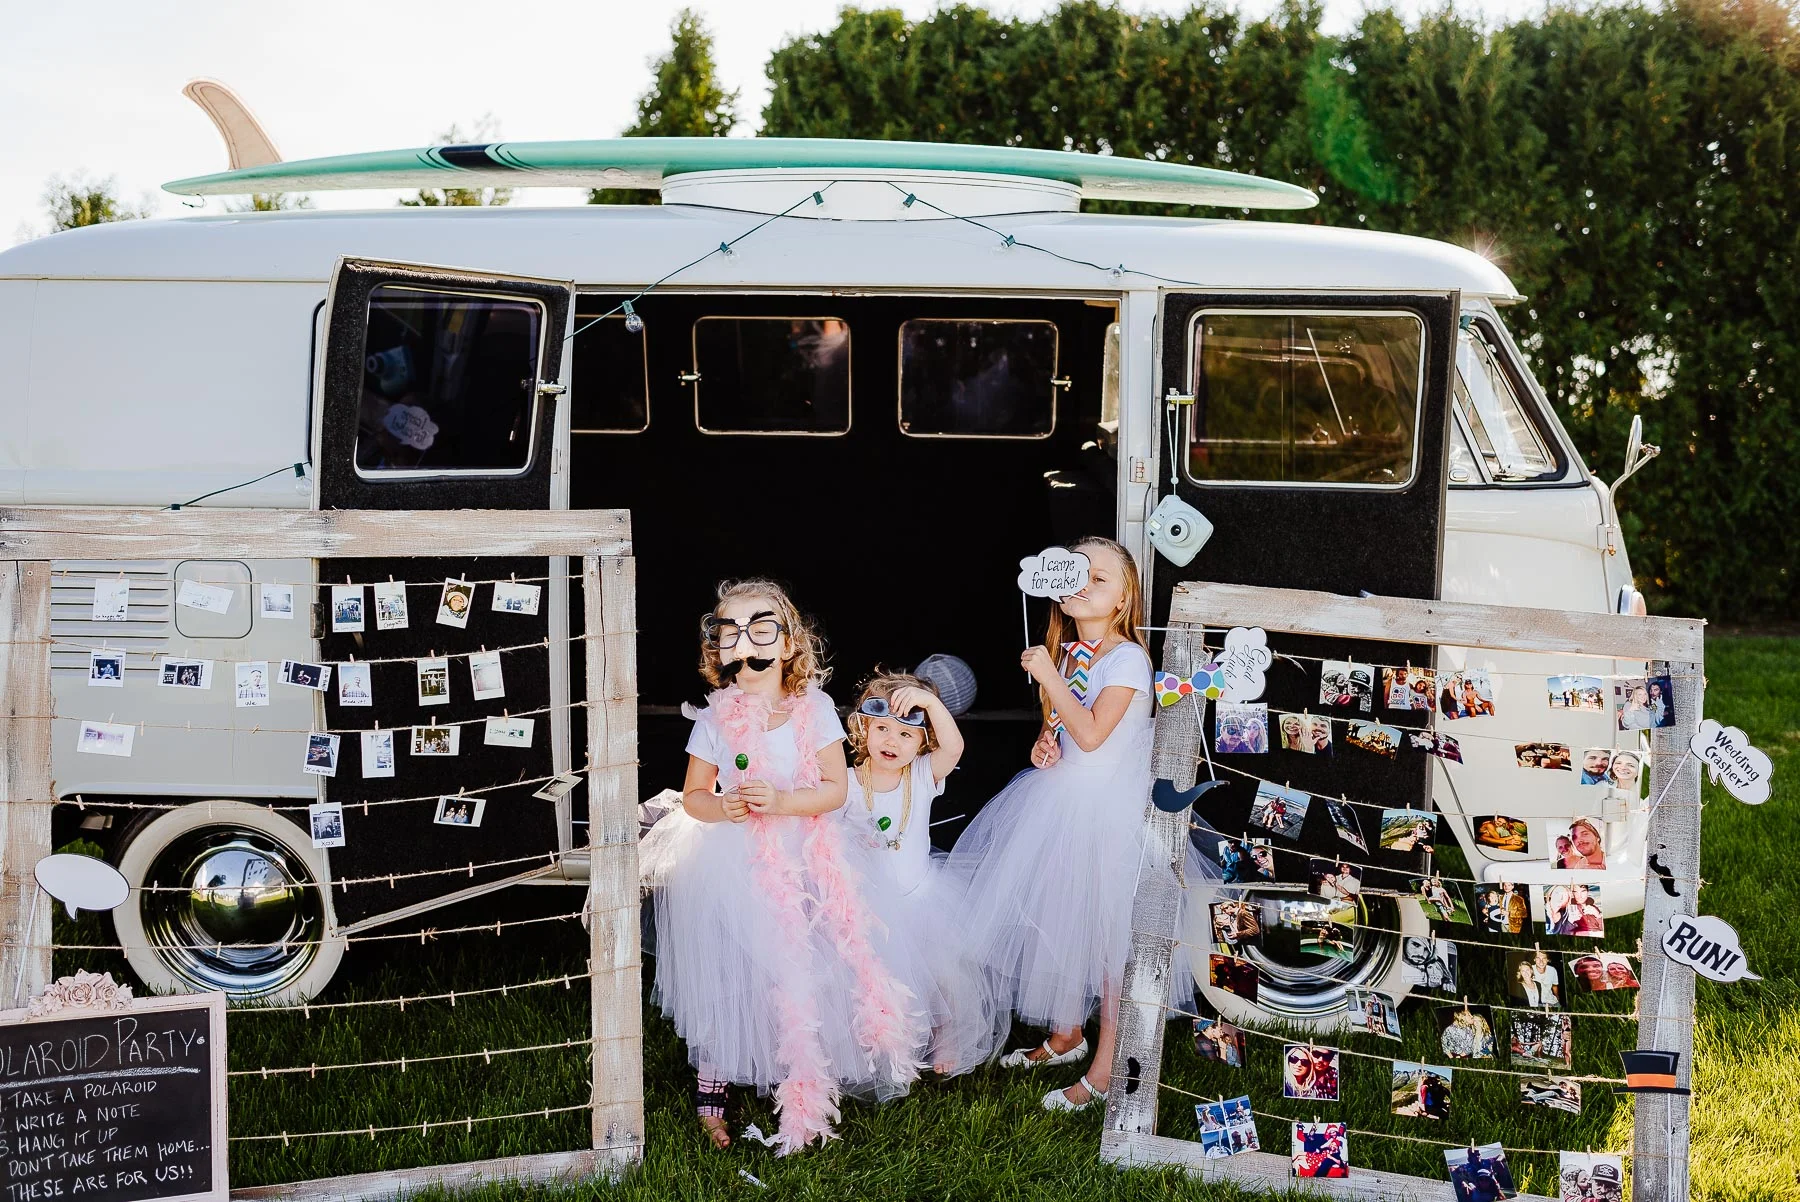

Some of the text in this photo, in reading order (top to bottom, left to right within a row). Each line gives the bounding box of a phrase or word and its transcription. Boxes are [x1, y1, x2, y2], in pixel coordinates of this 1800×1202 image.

[1031, 571, 1081, 589] for cake!
[1041, 557, 1075, 572] I came
[1224, 645, 1246, 690] Luck!
[1243, 644, 1267, 684] Good
[1704, 746, 1750, 789] Crasher!
[1714, 731, 1760, 782] Wedding
[1666, 921, 1741, 976] RUN!
[0, 1033, 110, 1077] LAROID
[8, 1089, 57, 1109] TAKE
[63, 1087, 75, 1104] A
[84, 1080, 157, 1099] POLAROID
[15, 1111, 65, 1133] WRITE
[76, 1108, 87, 1124] A
[97, 1103, 141, 1122] NOTE
[9, 1139, 210, 1177] DON'T TAKE THEM HOME...
[18, 1134, 65, 1155] HANG
[74, 1130, 91, 1146] IT
[98, 1127, 119, 1144] UP
[6, 1164, 194, 1202] THESE ARE FOR US!!
